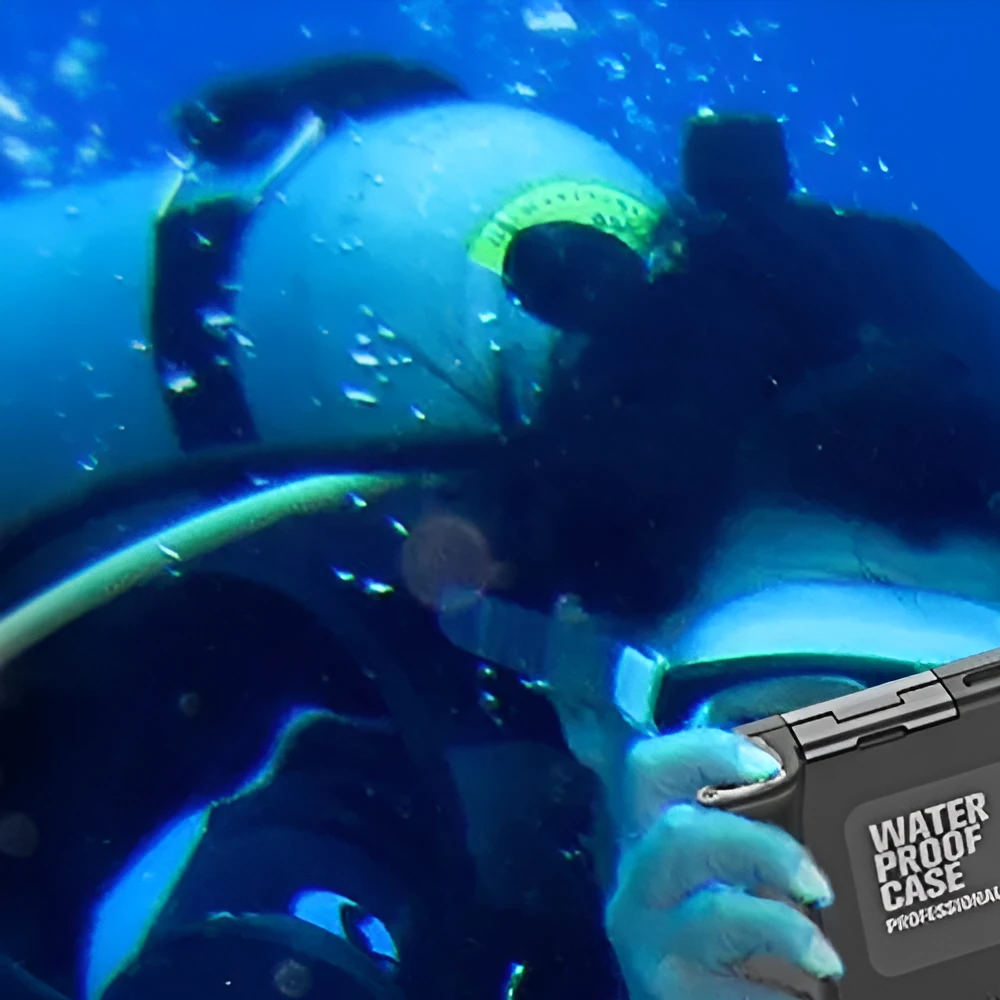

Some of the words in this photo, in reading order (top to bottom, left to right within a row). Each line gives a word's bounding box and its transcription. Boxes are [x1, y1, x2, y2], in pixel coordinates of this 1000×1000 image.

[868, 792, 990, 853] WATER
[874, 823, 982, 884] PROOF
[880, 861, 966, 912] CASE
